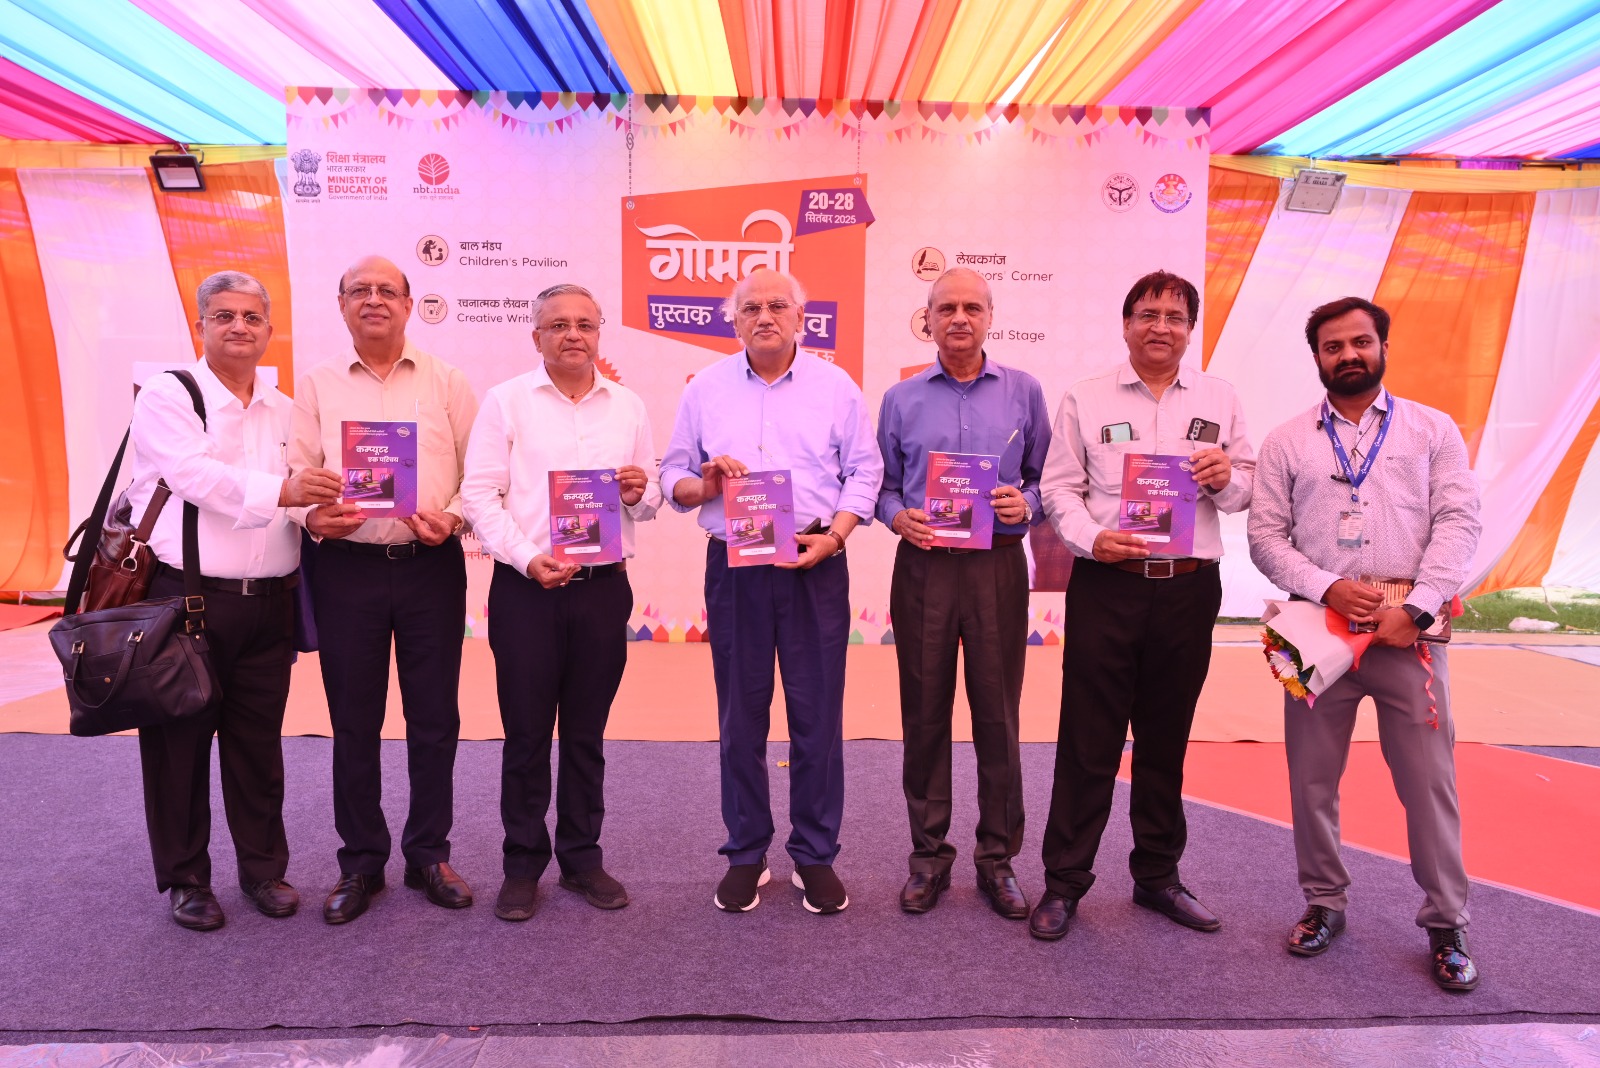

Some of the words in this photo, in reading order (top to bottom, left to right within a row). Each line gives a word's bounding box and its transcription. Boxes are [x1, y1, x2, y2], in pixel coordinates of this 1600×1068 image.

[326, 152, 350, 163] शिक्षा
[352, 152, 386, 164] मंत्रालय
[326, 165, 343, 173] भारत
[344, 165, 366, 173] सरकार
[328, 176, 372, 184] MINISTRY
[374, 176, 387, 184] OF
[328, 185, 388, 194] EDUCATION
[413, 184, 460, 194] nbt.india
[808, 192, 854, 210] 20-28
[805, 212, 833, 224] सितंबर
[835, 215, 857, 224] 2025
[459, 242, 479, 250] बाल
[481, 240, 502, 251] मंडप
[634, 209, 794, 283] गोमती
[459, 256, 518, 267] Children's
[522, 257, 568, 267] Pavilion
[956, 252, 1006, 265] लेखकगंज
[1011, 271, 1053, 281] Corner
[457, 299, 500, 308] रचनात्मक
[503, 297, 529, 308] लेखन
[457, 313, 503, 323] Creative
[650, 302, 713, 328] पुस्तक
[1008, 330, 1045, 342] Stage
